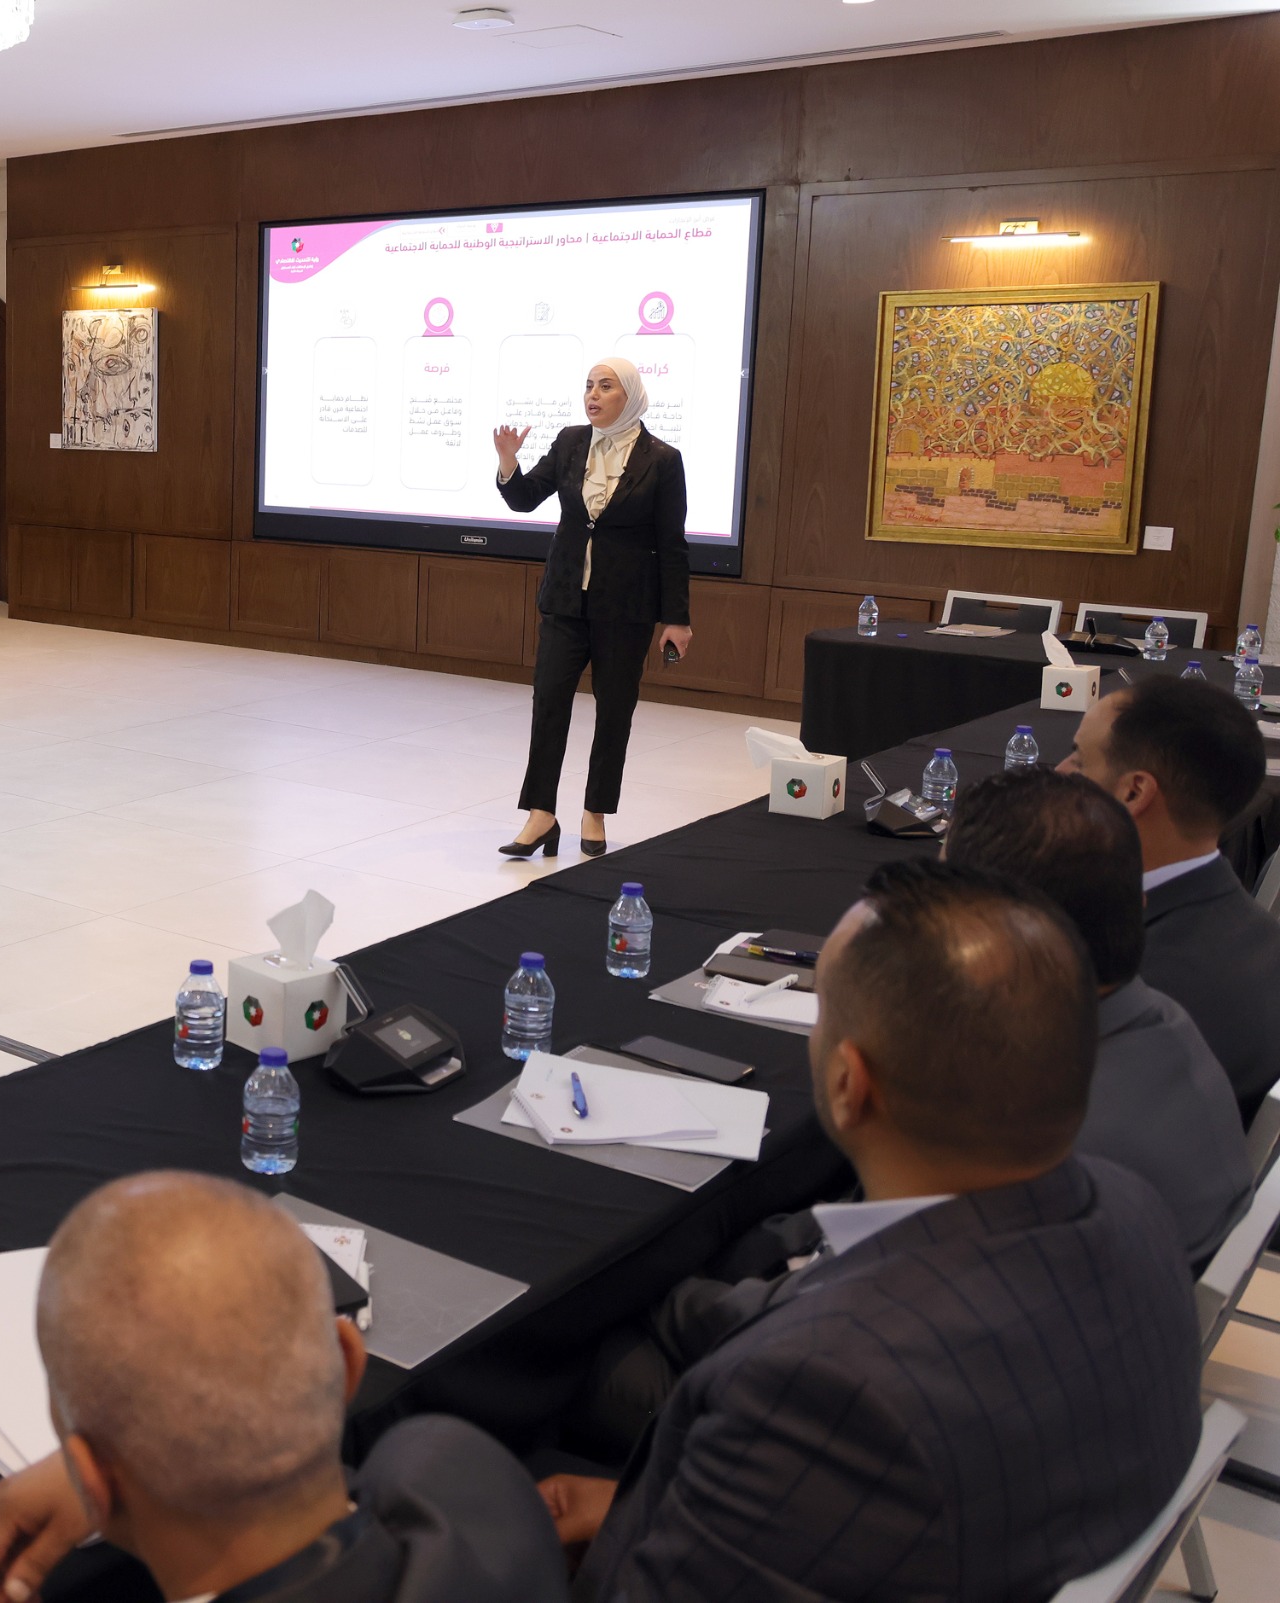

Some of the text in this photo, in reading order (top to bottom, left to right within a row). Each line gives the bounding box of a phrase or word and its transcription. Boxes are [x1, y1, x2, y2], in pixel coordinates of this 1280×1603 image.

[556, 234, 582, 246] محاور
[592, 230, 641, 244] الاجتماعية
[645, 229, 681, 242] الحماية
[684, 228, 712, 240] قطاع
[385, 242, 427, 254] الاجتماعية
[430, 240, 460, 252] للحماية
[463, 238, 496, 251] الوطنية
[499, 235, 554, 249] الاستراتيجية
[424, 362, 450, 376] فرصة
[638, 363, 669, 377] كرامة
